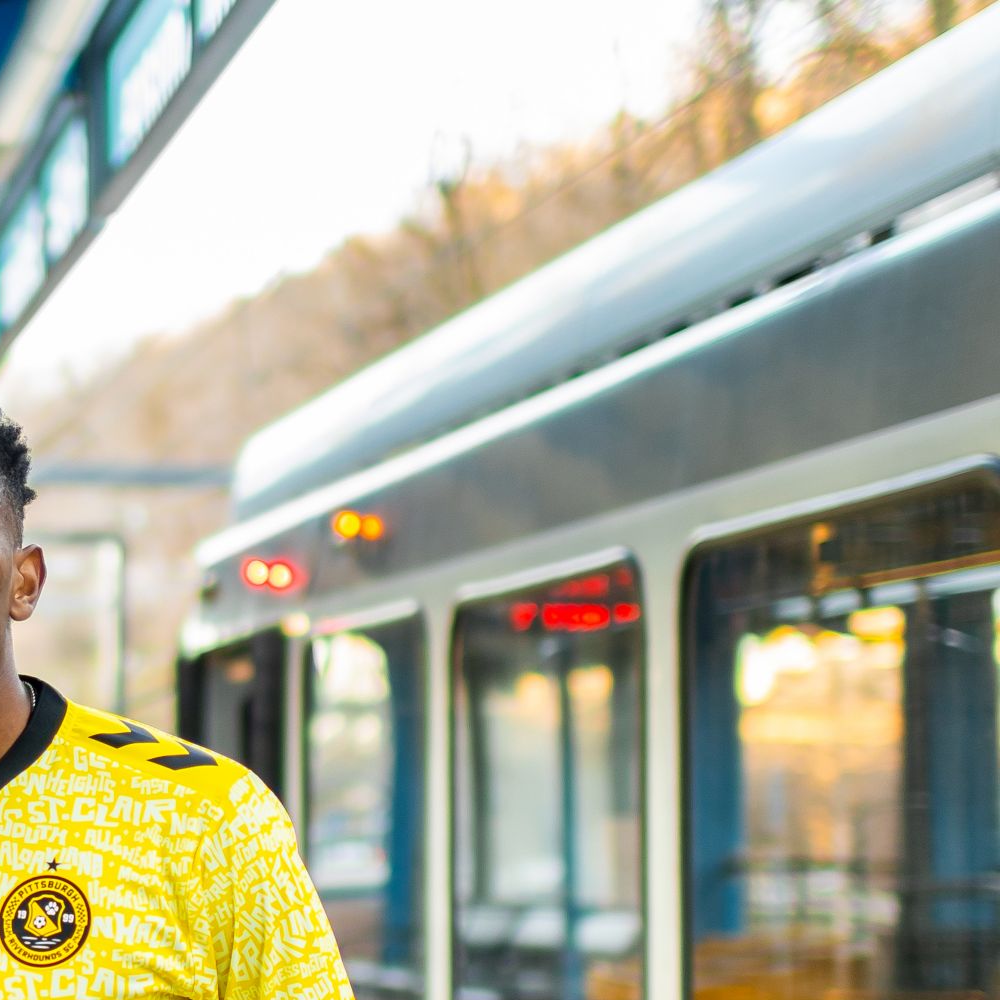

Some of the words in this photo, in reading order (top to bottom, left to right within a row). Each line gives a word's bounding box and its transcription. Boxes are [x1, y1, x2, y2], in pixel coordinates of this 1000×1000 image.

[18, 880, 81, 903] PITTSBURGH
[61, 913, 75, 924] 99
[8, 938, 63, 962] RIVERHOUNDS
[63, 943, 75, 954] SC
